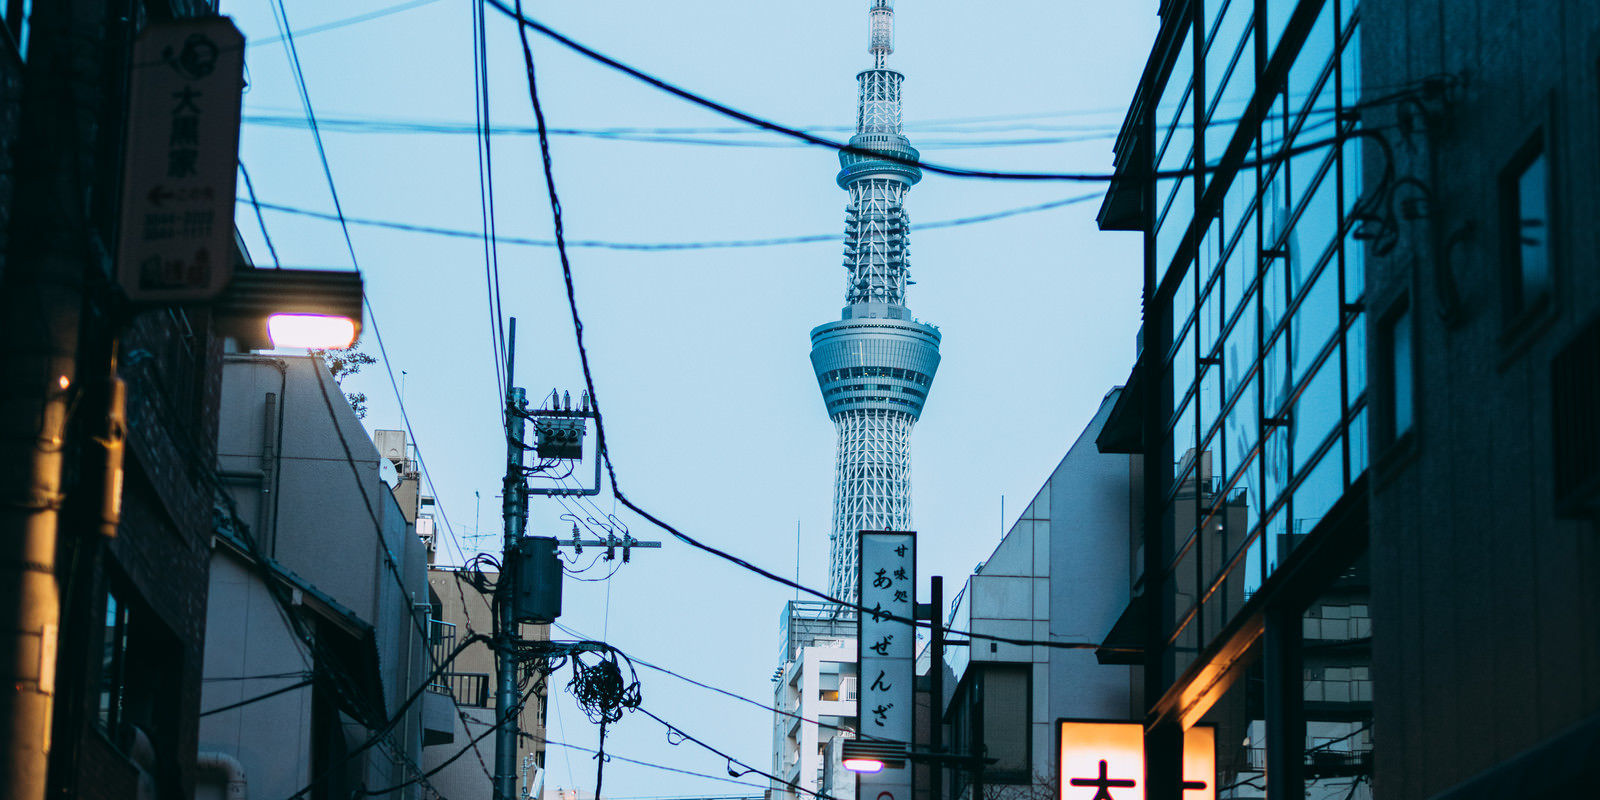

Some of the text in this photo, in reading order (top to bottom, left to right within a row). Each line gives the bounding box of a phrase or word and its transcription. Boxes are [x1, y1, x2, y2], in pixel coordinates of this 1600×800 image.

[893, 544, 908, 604] 甘味処
[870, 568, 894, 727] あわぜんざ
